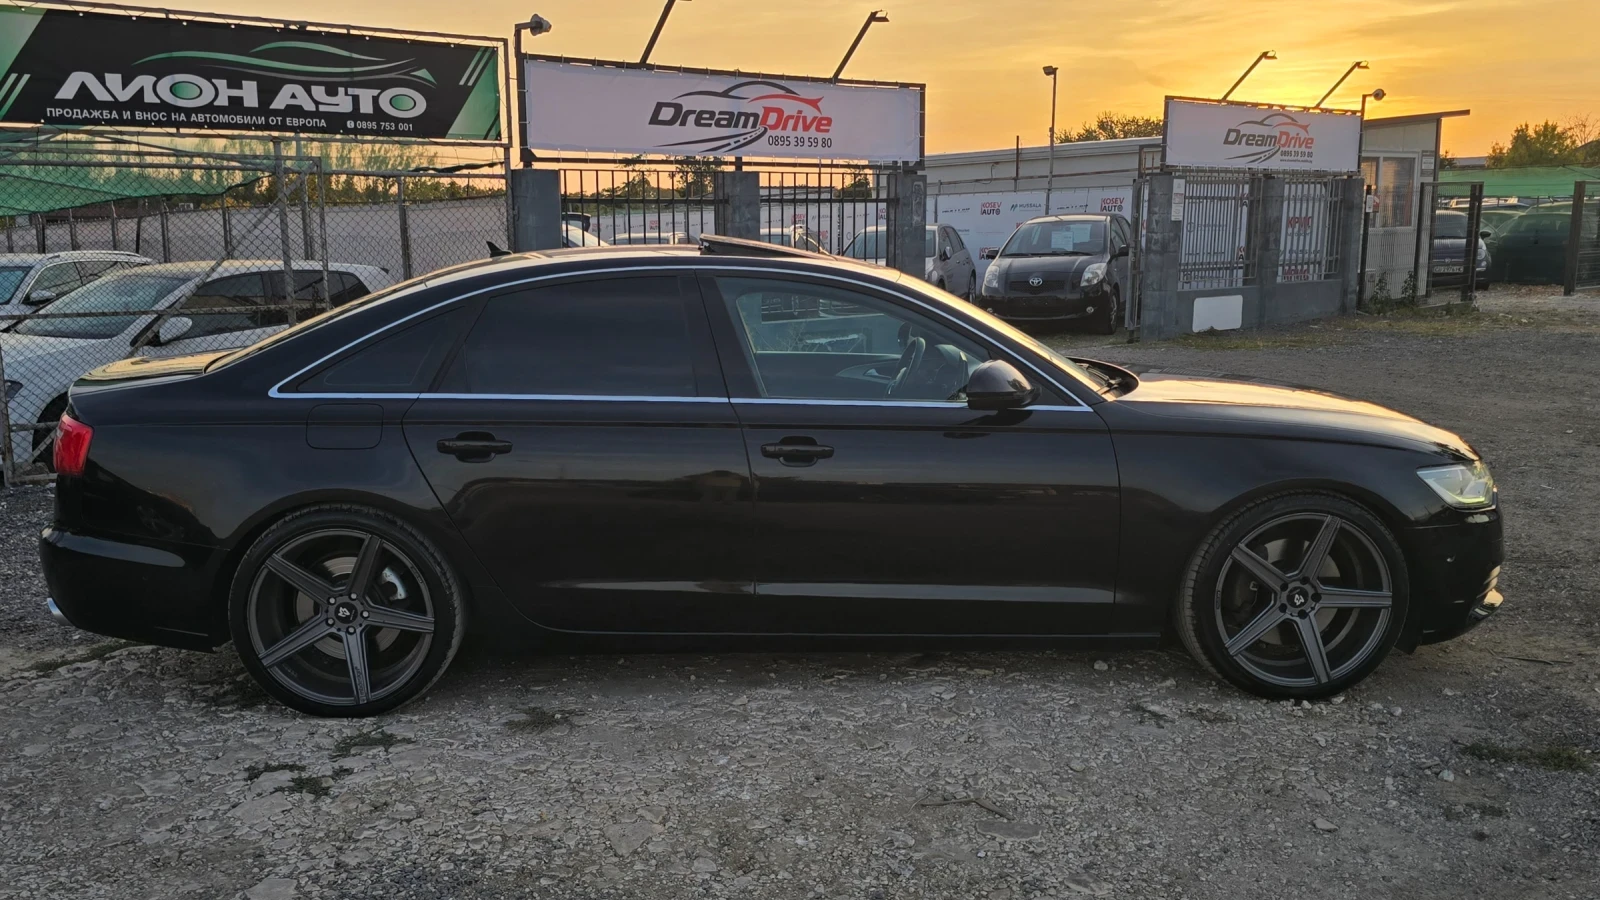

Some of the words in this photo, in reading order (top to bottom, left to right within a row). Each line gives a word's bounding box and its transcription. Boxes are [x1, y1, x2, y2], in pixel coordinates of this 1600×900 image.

[54, 71, 259, 108] ЛИОН
[269, 83, 427, 119] АУТО
[46, 107, 119, 120] ПРОДАЖБА
[122, 111, 131, 120] И
[135, 111, 167, 122] ВНОС
[171, 112, 187, 122] НА
[190, 113, 265, 125] АВТОМОБИЛИ
[268, 116, 282, 126] ОТ
[286, 117, 327, 127] ЕВРОПА
[356, 121, 377, 130] 0895
[380, 122, 395, 131] 753
[398, 123, 413, 131] 001
[648, 101, 833, 133] DreamDrive
[768, 135, 791, 147] 0895
[794, 136, 805, 148] 39
[807, 137, 819, 148] 59
[821, 137, 832, 148] 80
[1223, 128, 1315, 149] DreamDrive
[1280, 150, 1292, 158] 0895
[1293, 150, 1299, 158] 39
